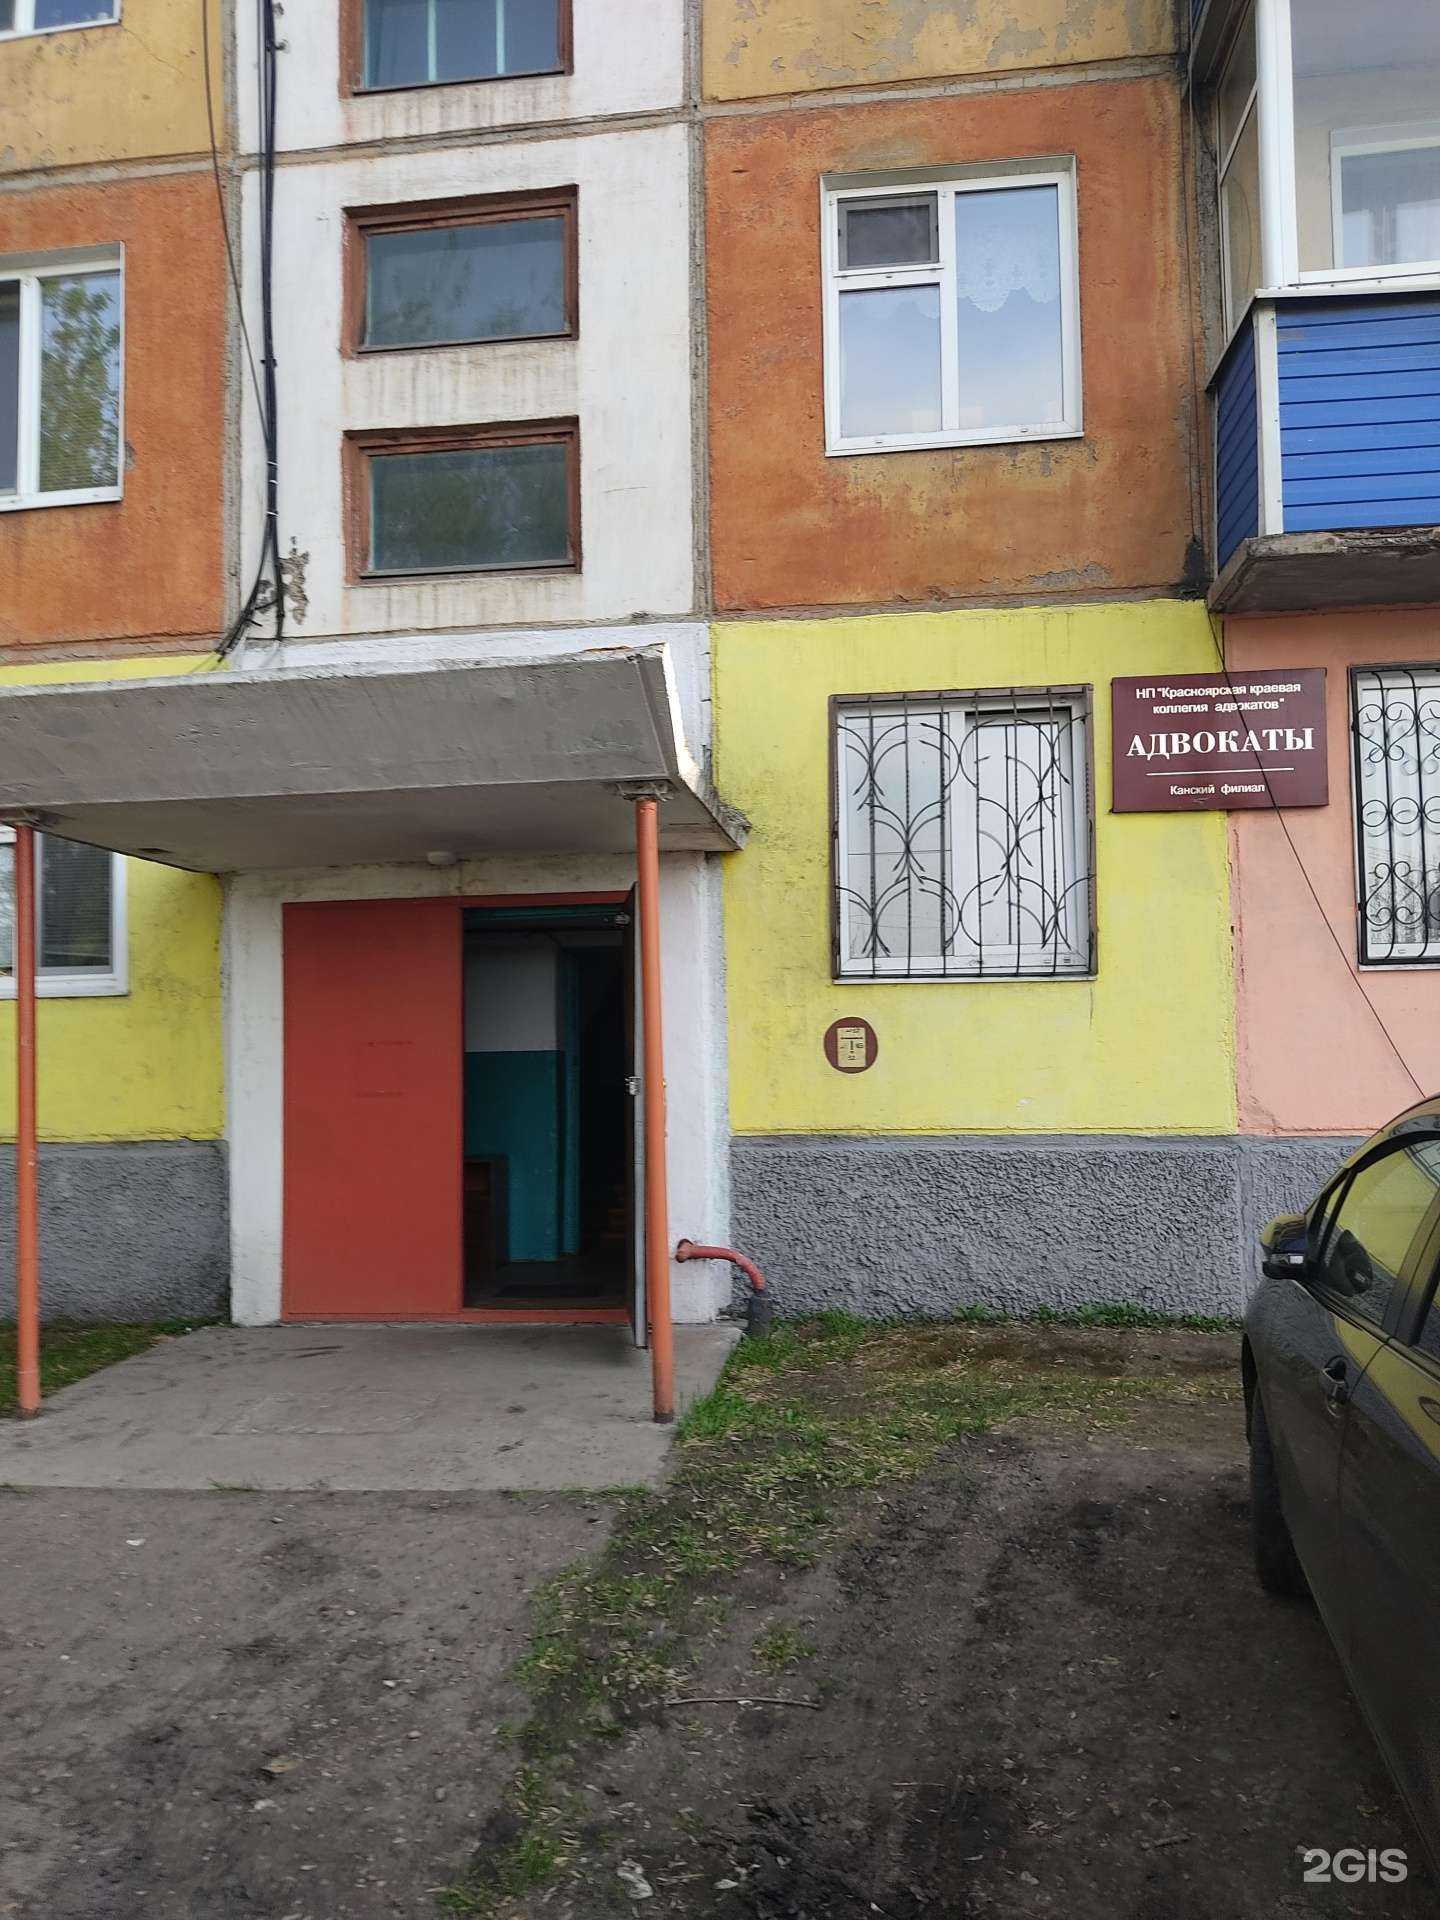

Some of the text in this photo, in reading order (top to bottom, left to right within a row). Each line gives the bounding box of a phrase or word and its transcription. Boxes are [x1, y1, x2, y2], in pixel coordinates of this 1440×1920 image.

[1135, 683, 1301, 699] НП "Красноярская краевая
[1153, 703, 1208, 715] коллегия
[1126, 728, 1315, 760] АДВОКАТЫ
[1170, 783, 1265, 795] Канский филиал
